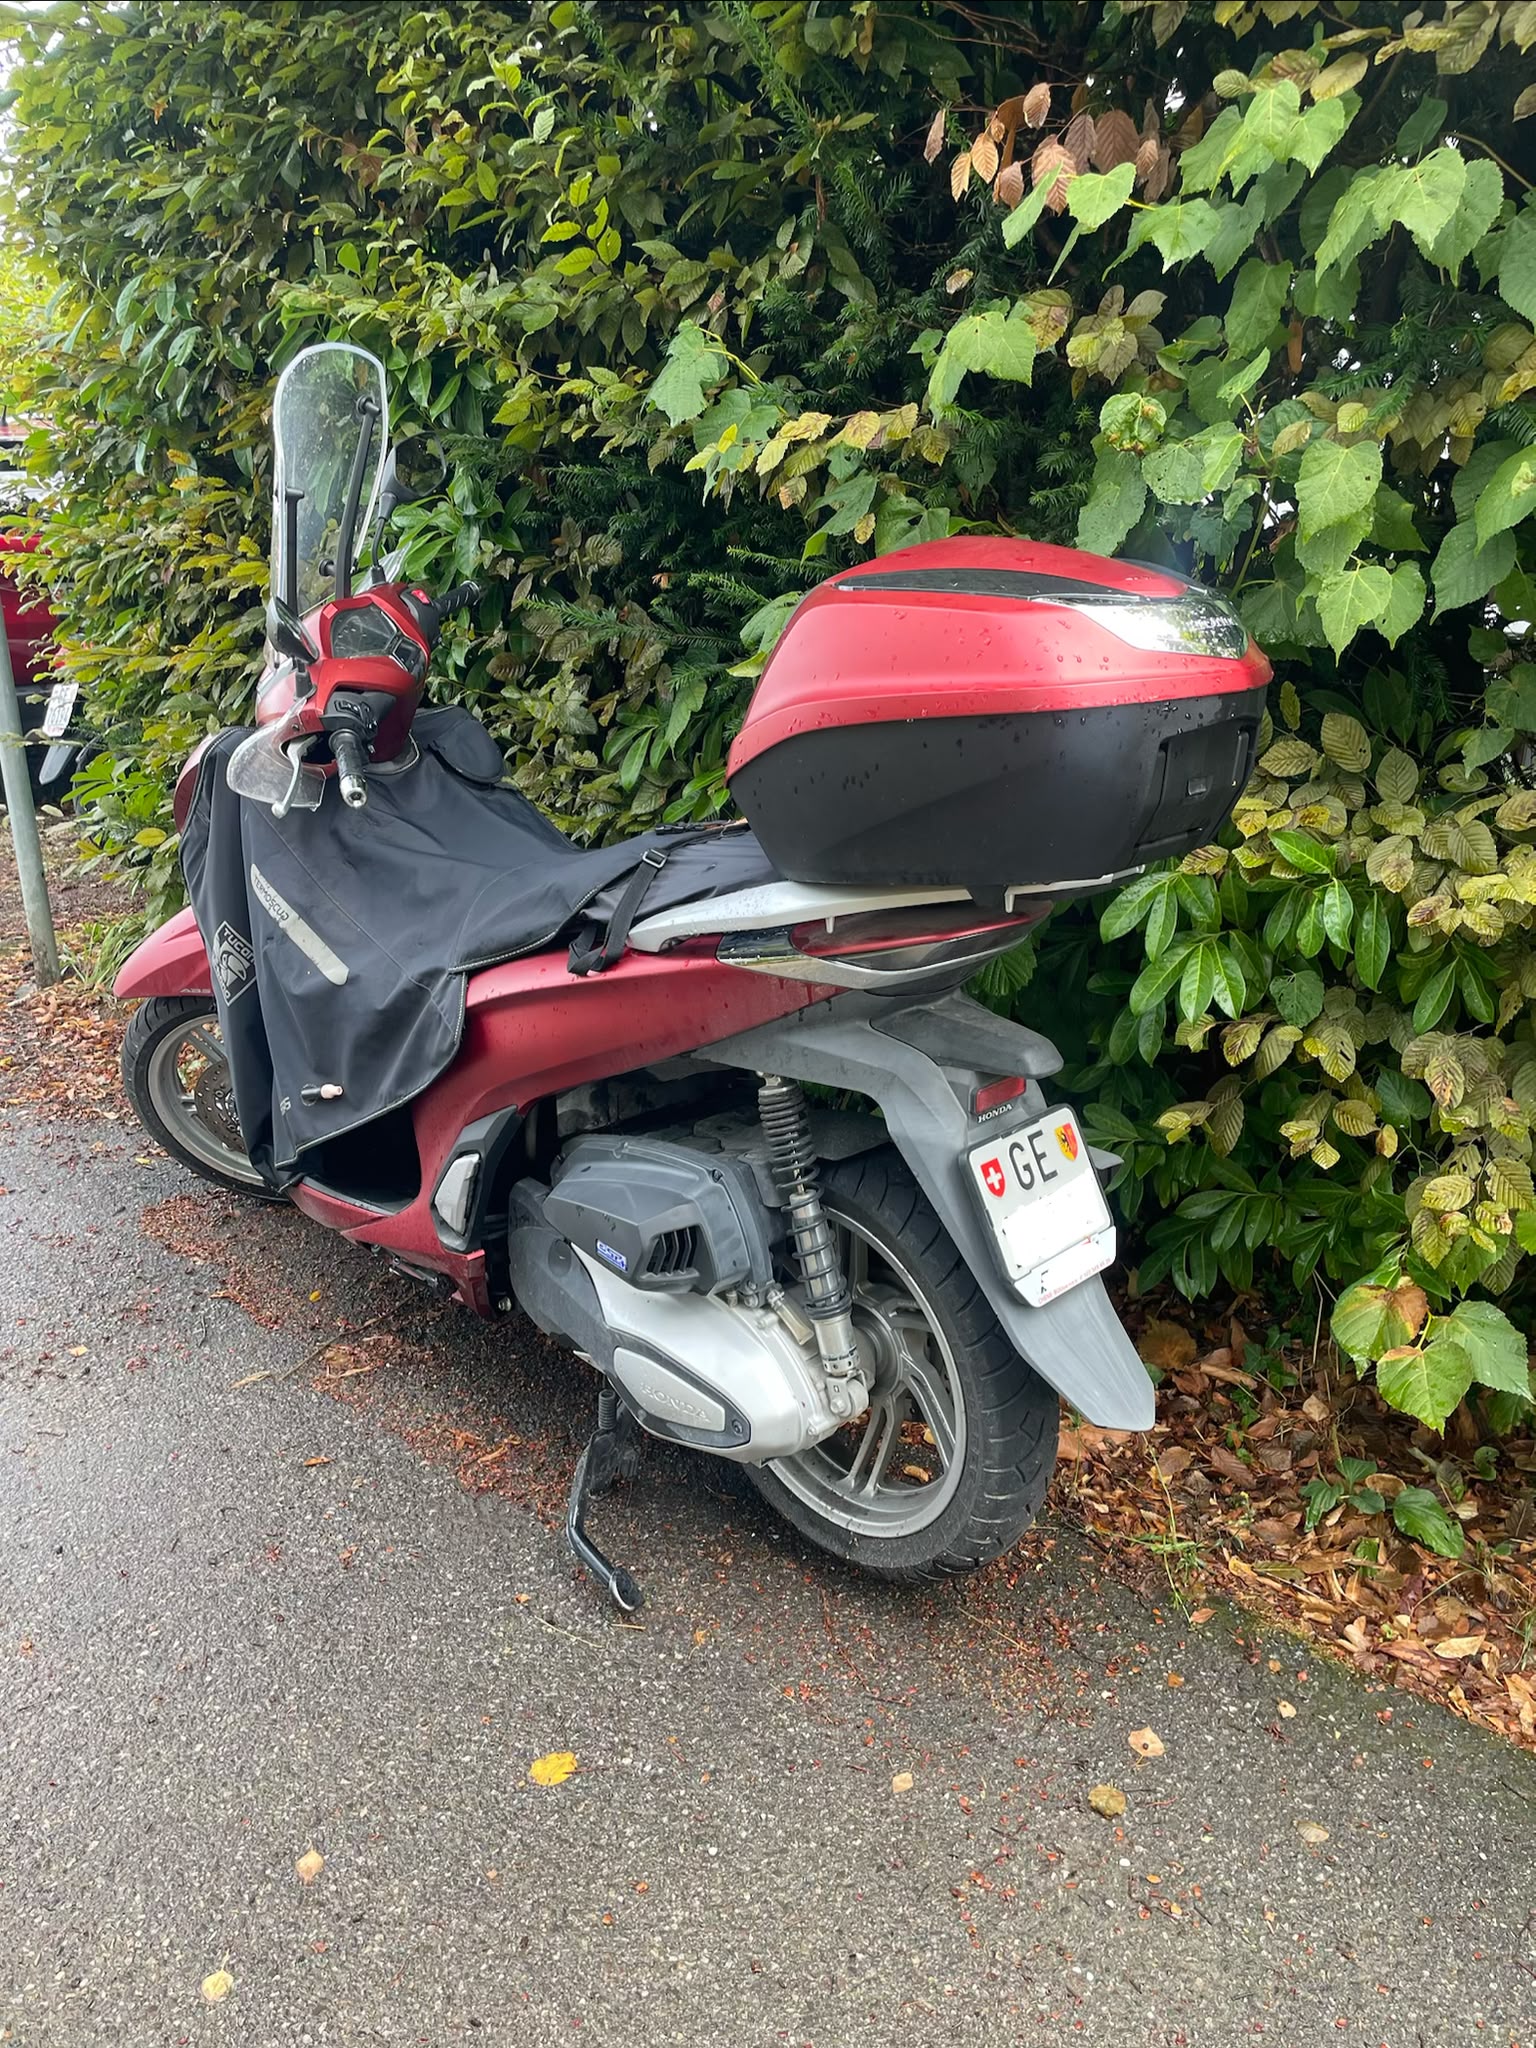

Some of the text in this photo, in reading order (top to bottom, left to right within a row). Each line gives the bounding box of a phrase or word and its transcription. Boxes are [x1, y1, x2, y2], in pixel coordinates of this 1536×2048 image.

[978, 1104, 1012, 1123] HONDA
[1008, 1129, 1058, 1190] GE
[640, 1383, 711, 1423] HONDA
